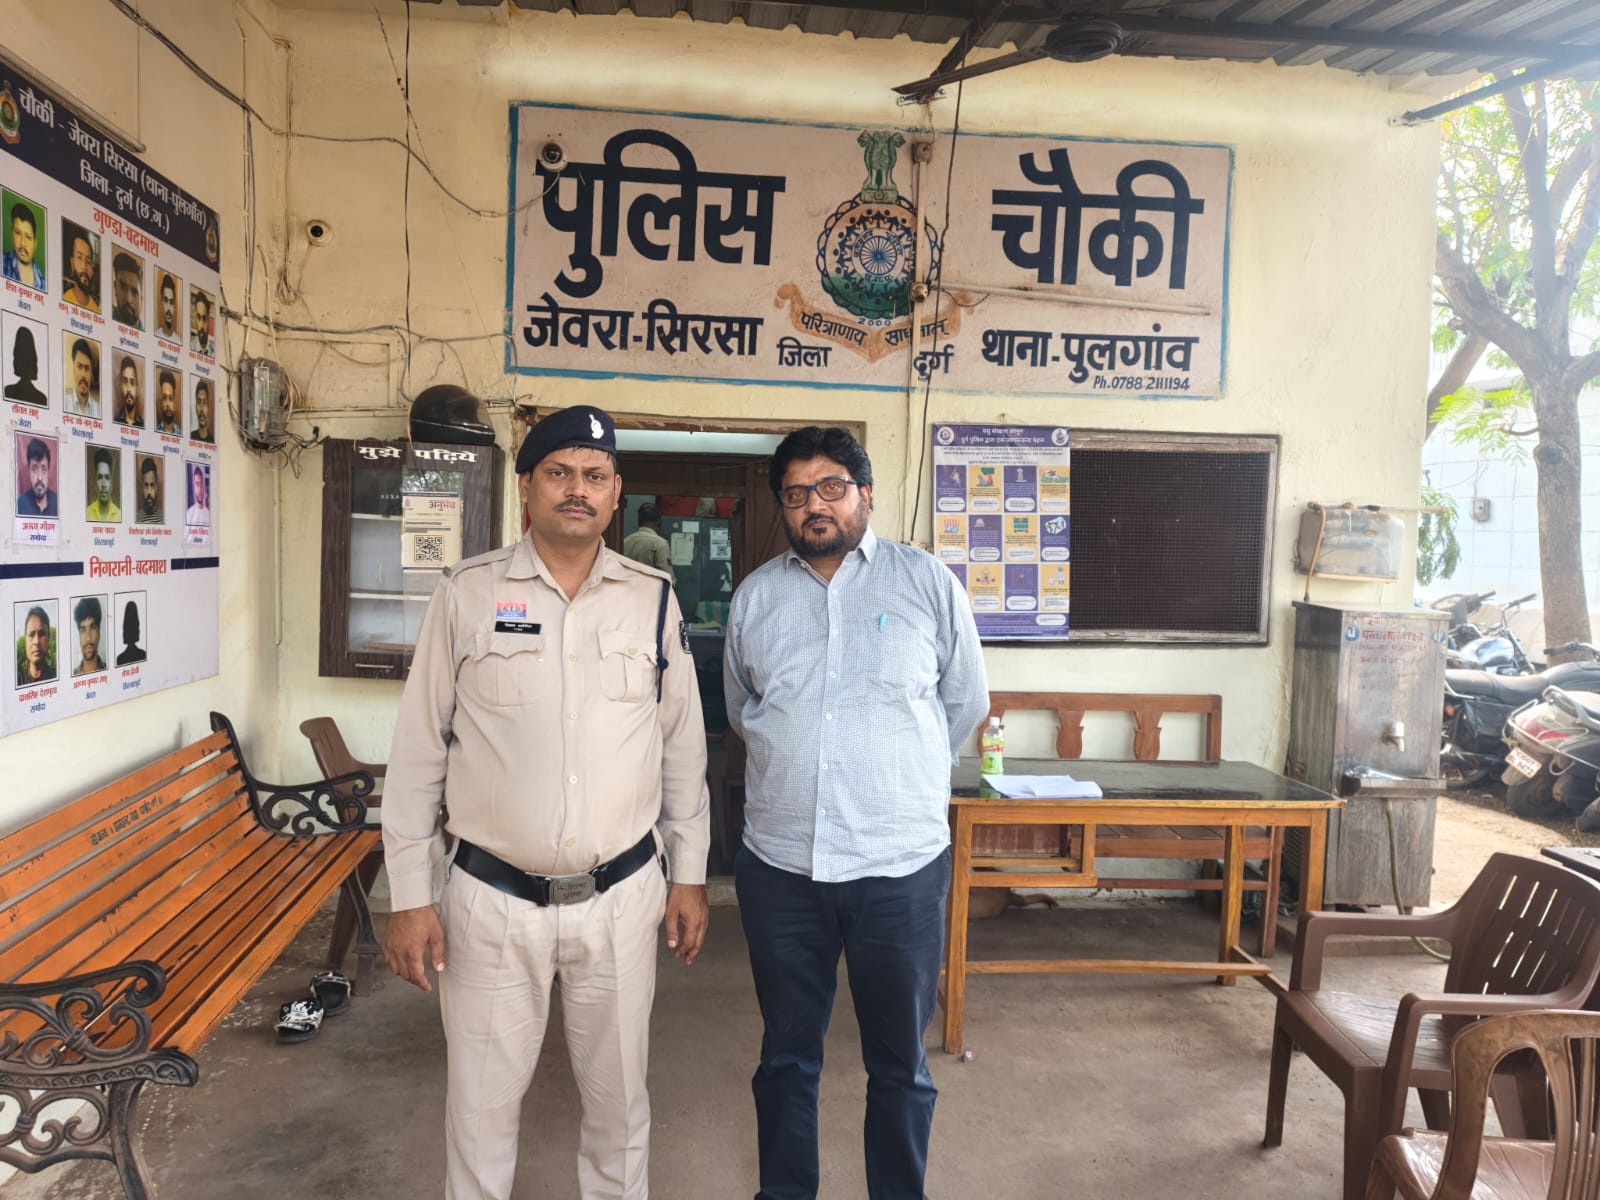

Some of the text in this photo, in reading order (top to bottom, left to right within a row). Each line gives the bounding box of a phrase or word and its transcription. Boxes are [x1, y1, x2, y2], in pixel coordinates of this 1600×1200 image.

[19, 87, 54, 128] चौकी
[68, 118, 100, 159] जेवरा
[104, 140, 138, 184] सिरसा
[116, 185, 133, 211] दुर्ग
[136, 197, 170, 235] (छ.ग.)
[535, 128, 1205, 299] पुलिस चौकी
[93, 207, 159, 258] गुण्डा-बदमाश
[523, 292, 1200, 384] जेवरा-सिरसा जिला दुर्ग थाना-पुलगांव
[800, 311, 868, 346] परित्राणाय
[858, 318, 892, 327] 2000
[358, 446, 479, 464] मुझे पढ़िये
[429, 501, 456, 511] अनुभव
[89, 555, 167, 578] निगरानी-बदमाश
